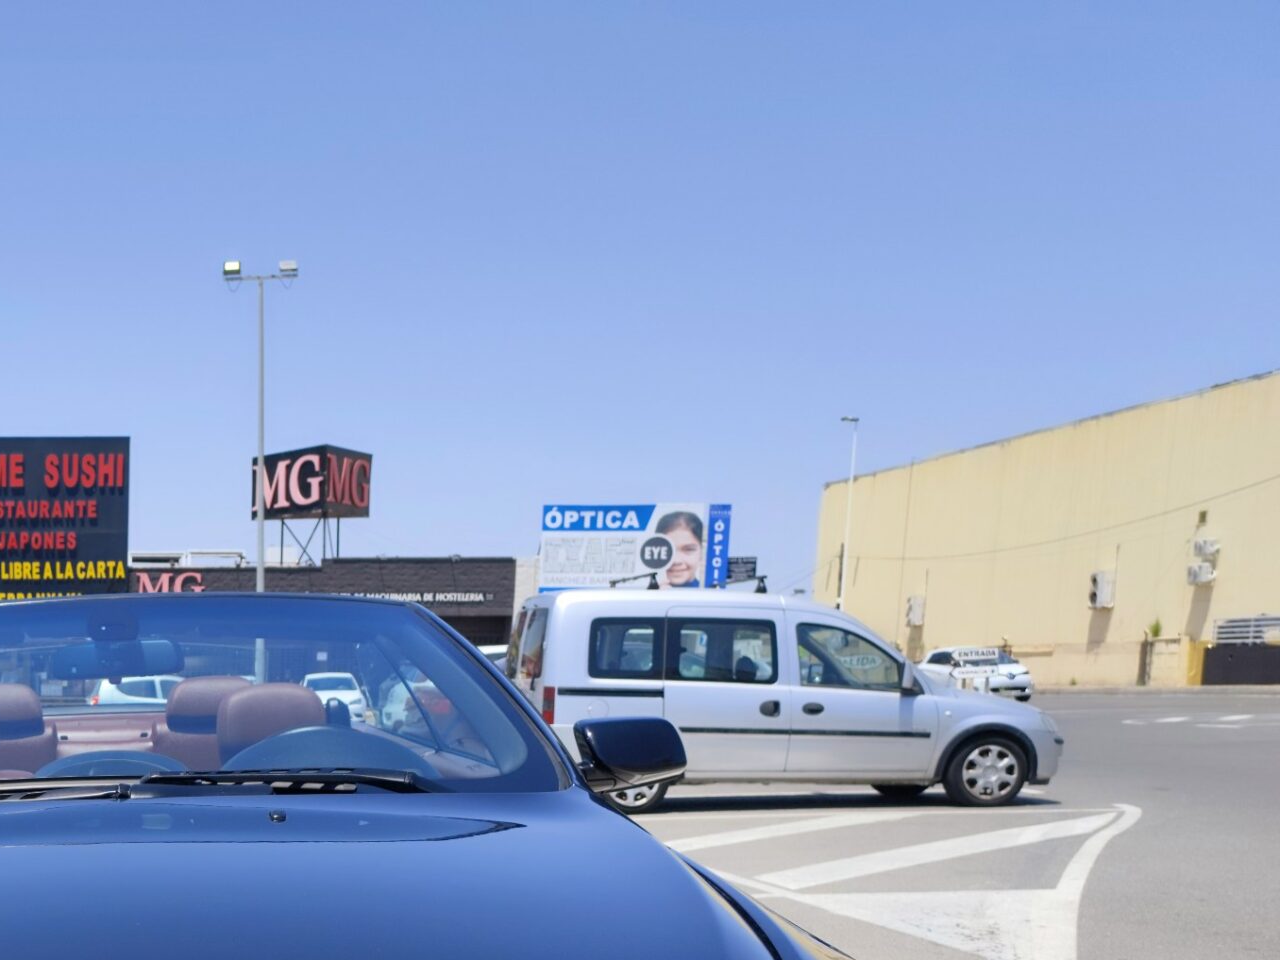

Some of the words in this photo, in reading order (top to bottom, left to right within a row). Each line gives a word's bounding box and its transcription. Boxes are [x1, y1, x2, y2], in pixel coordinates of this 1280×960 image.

[44, 453, 125, 488] SUSHI
[326, 453, 370, 508] MG
[252, 453, 324, 511] MG
[544, 507, 640, 529] ÓPTICA
[644, 546, 668, 560] EYE
[1, 561, 40, 581] LIBRE
[43, 561, 53, 580] A
[56, 561, 74, 580] LA
[76, 560, 126, 579] CARTA
[136, 571, 206, 592] MG
[423, 592, 434, 602] DE
